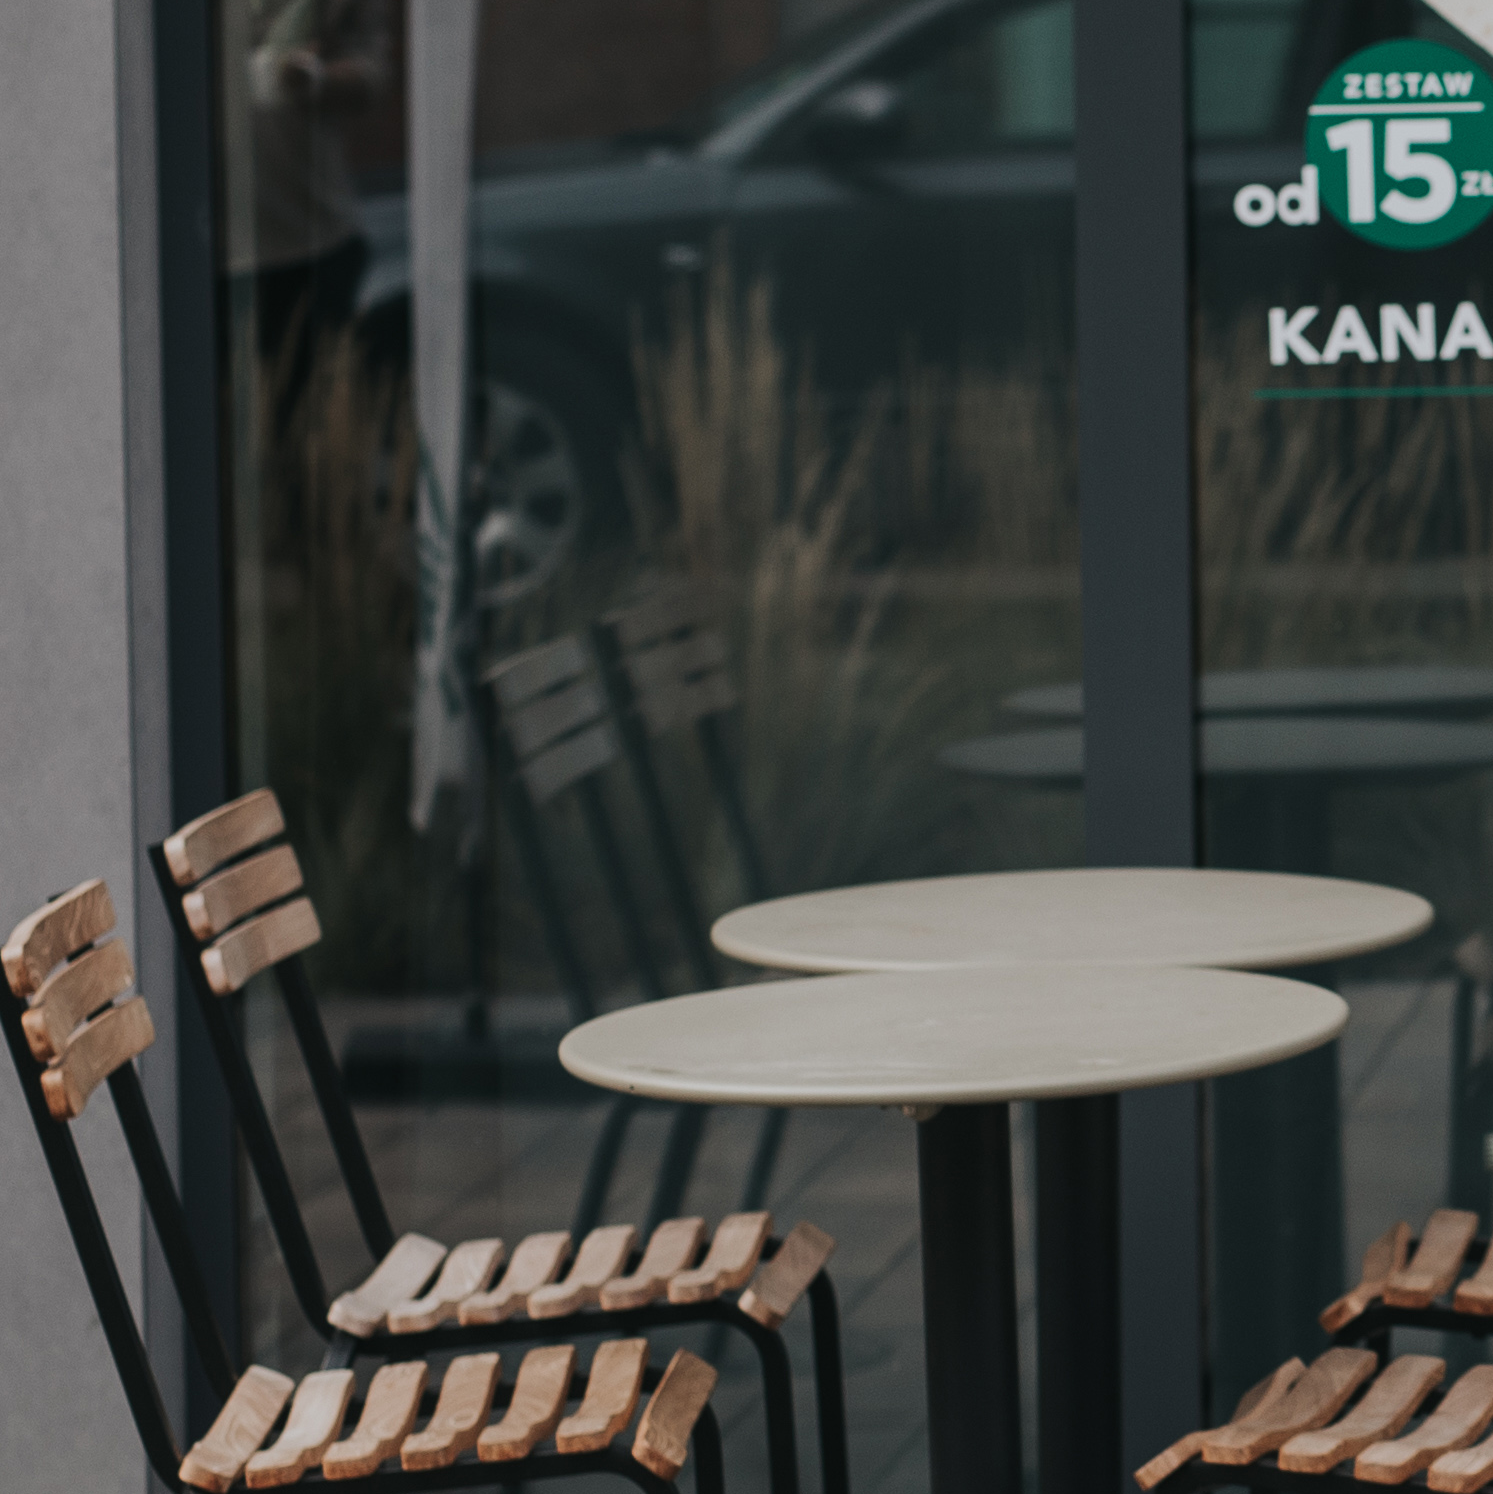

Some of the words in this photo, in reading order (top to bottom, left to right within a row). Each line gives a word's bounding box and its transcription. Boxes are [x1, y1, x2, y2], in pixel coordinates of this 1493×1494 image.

[1342, 71, 1474, 100] ZESTAW
[1232, 162, 1320, 228] od
[1325, 117, 1458, 225] 15
